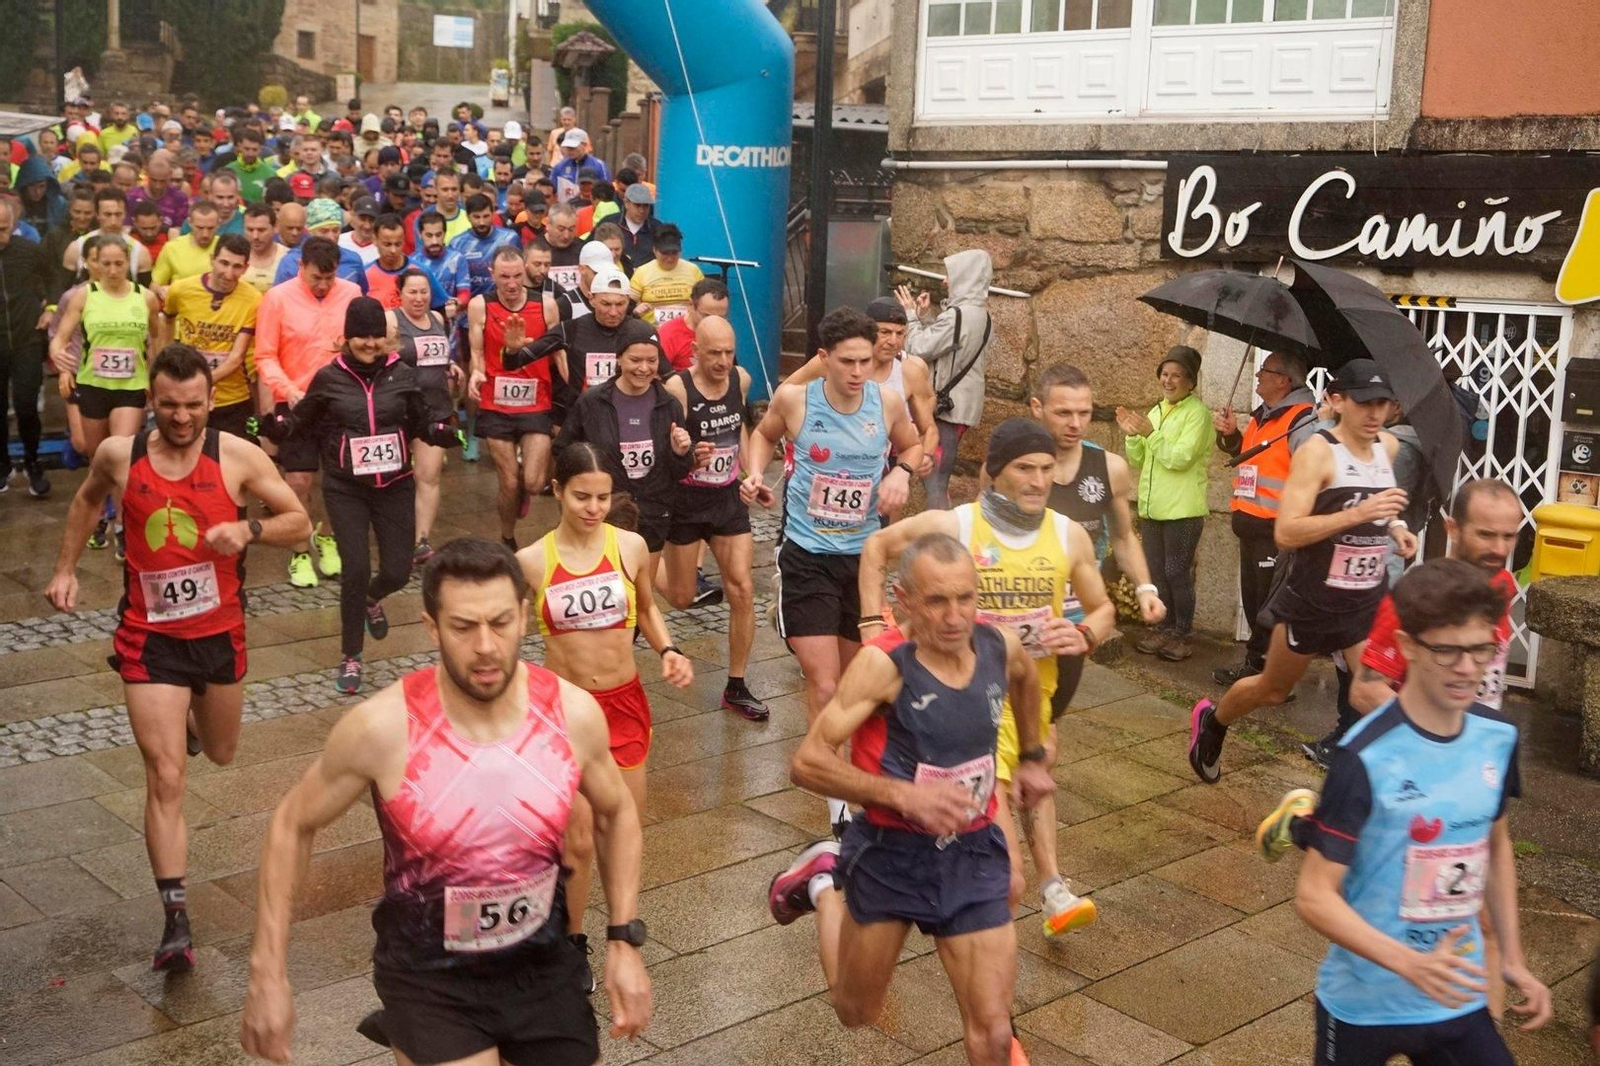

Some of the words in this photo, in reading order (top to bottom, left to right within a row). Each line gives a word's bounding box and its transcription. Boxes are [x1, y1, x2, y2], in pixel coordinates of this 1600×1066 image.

[1168, 165, 1263, 258] Bo
[1288, 170, 1562, 260] Camiño
[101, 354, 130, 370] 251
[502, 385, 530, 399] 107
[700, 420, 708, 429] O
[711, 412, 741, 429] BARCO
[361, 443, 395, 463] 245
[821, 486, 863, 510] 148
[1343, 556, 1379, 577] 159
[162, 578, 198, 605] 49
[977, 576, 1055, 593] ATHLETICS
[560, 585, 616, 619] 202
[478, 896, 529, 930] 56
